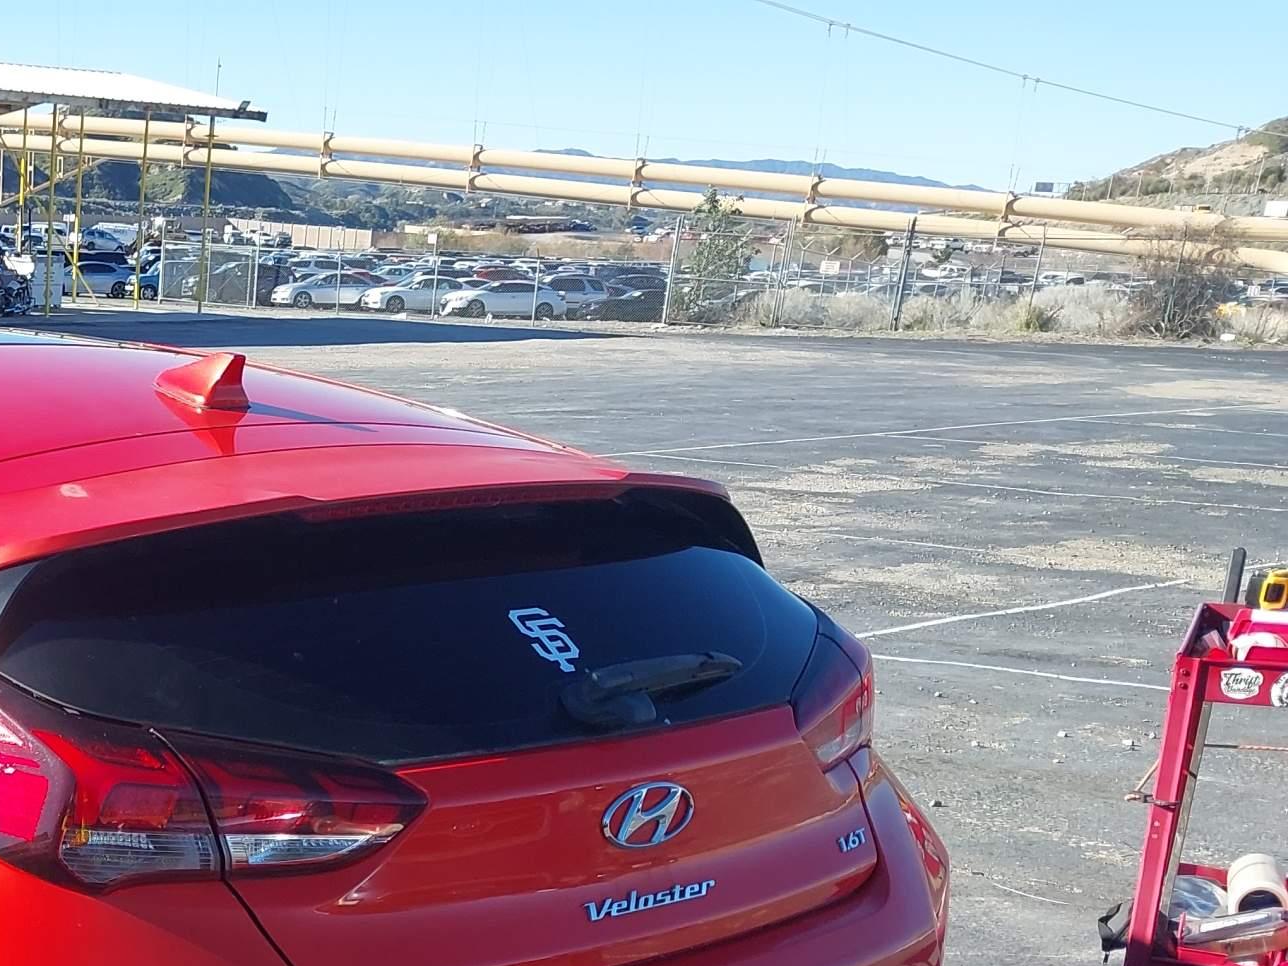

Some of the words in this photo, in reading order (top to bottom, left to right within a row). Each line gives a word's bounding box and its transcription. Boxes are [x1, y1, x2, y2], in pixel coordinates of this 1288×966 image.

[508, 607, 579, 672] SF
[1223, 672, 1260, 689] Thrift
[584, 880, 715, 921] Veloster
